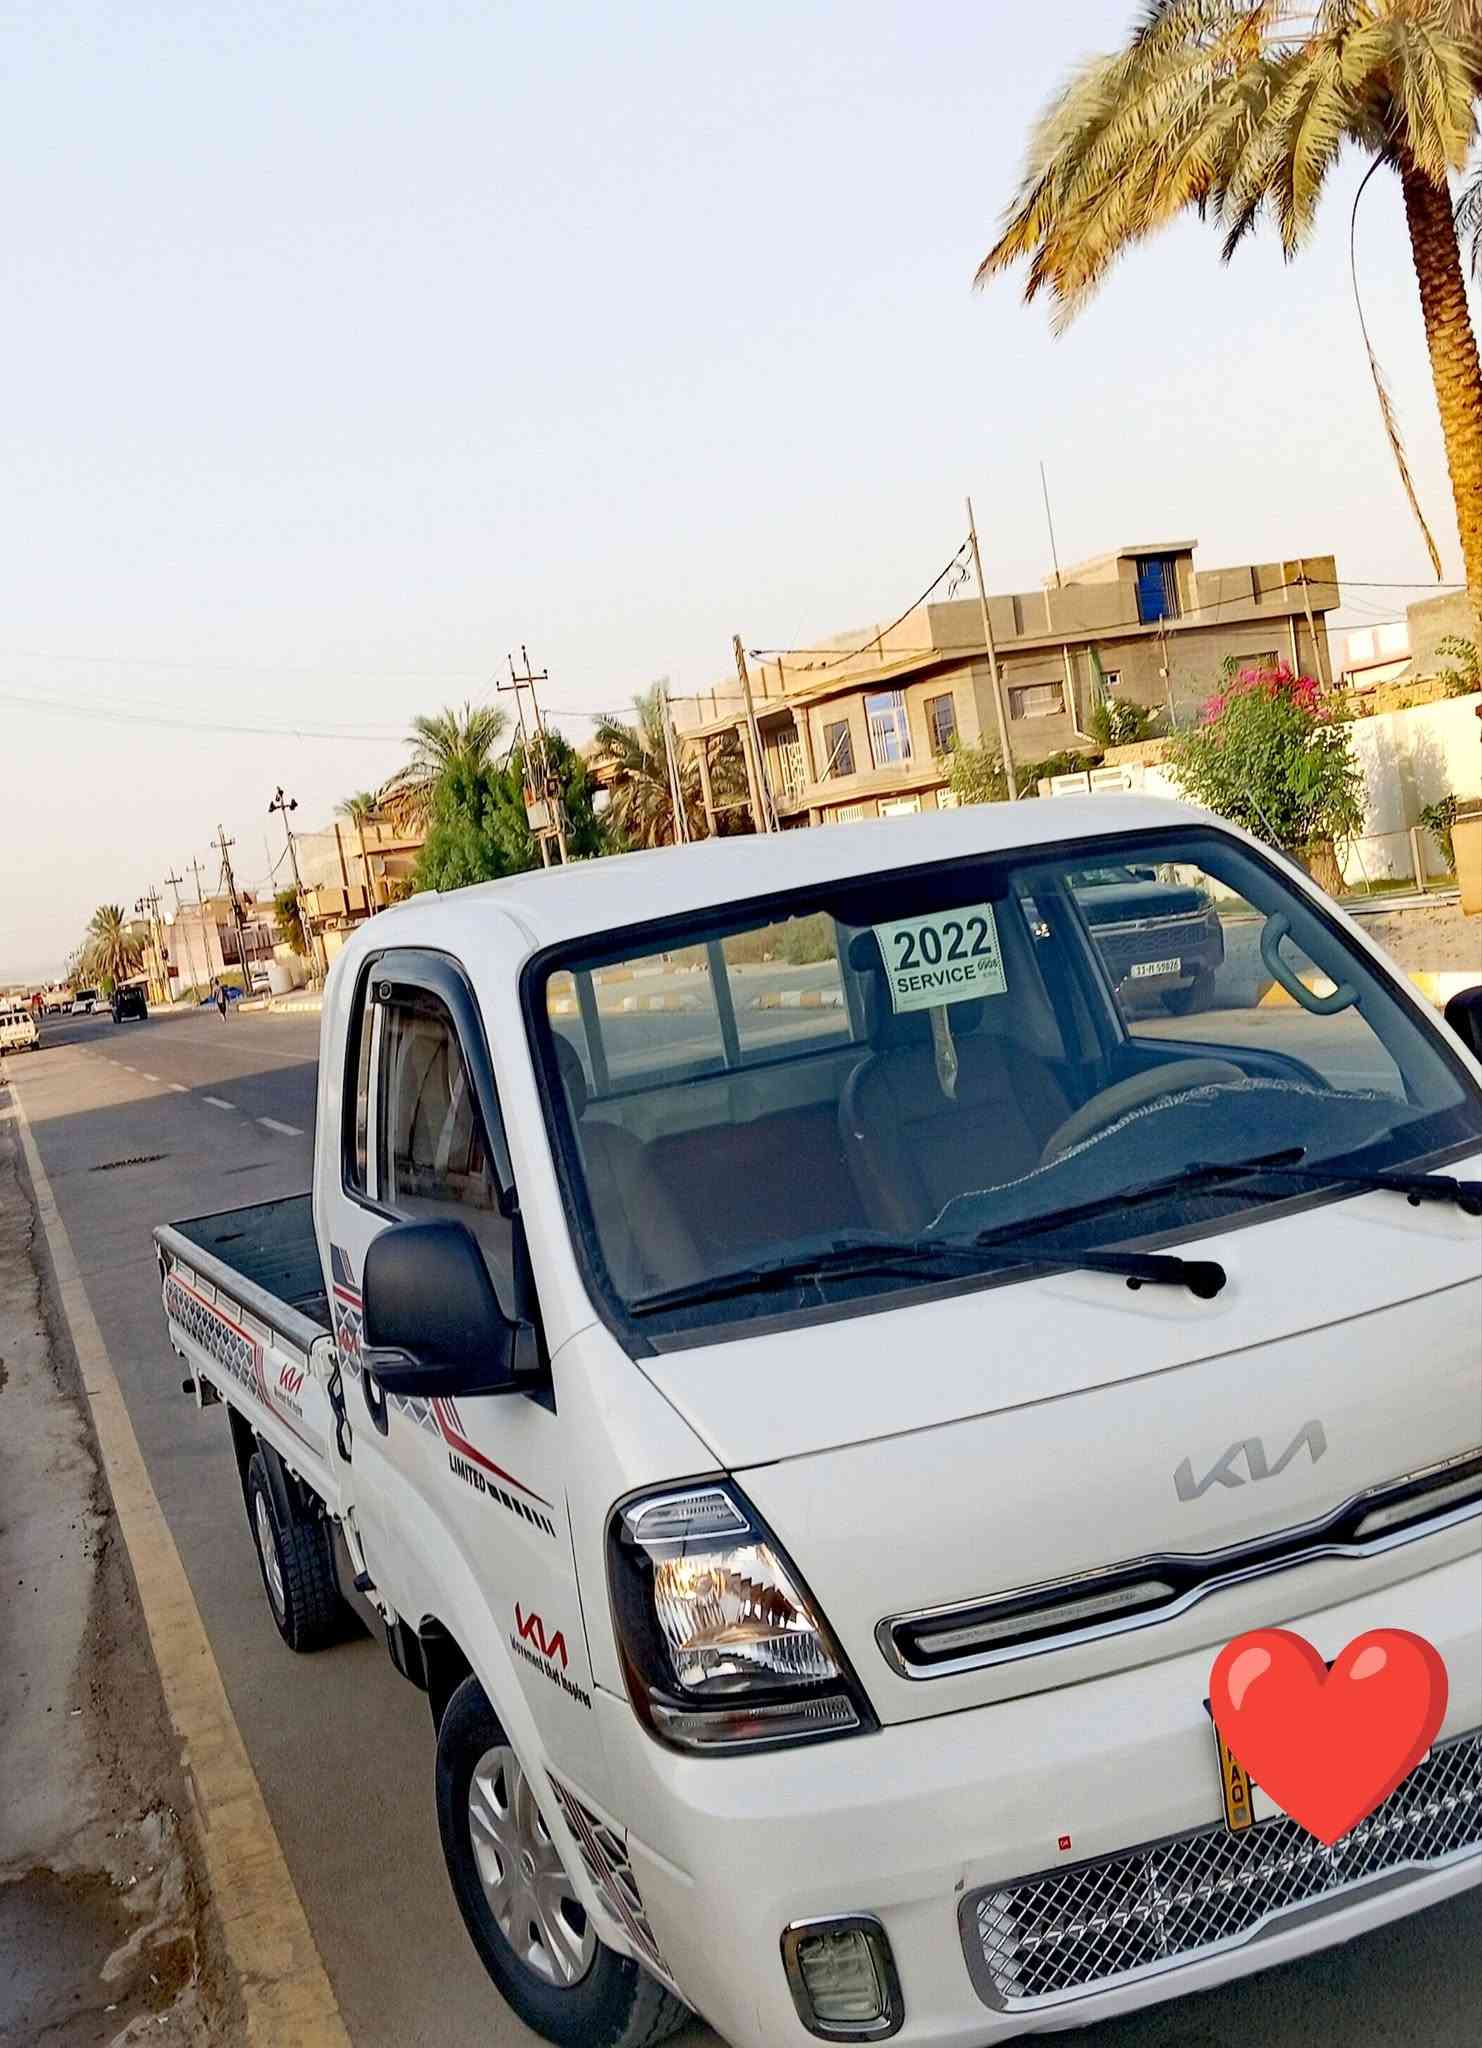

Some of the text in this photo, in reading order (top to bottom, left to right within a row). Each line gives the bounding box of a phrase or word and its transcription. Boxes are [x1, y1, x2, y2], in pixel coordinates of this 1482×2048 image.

[894, 916, 992, 972] 2022
[897, 964, 977, 993] SERVICE
[449, 1452, 487, 1494] LIMITED
[1173, 1419, 1328, 1502] KIA
[514, 1600, 569, 1671] KIA
